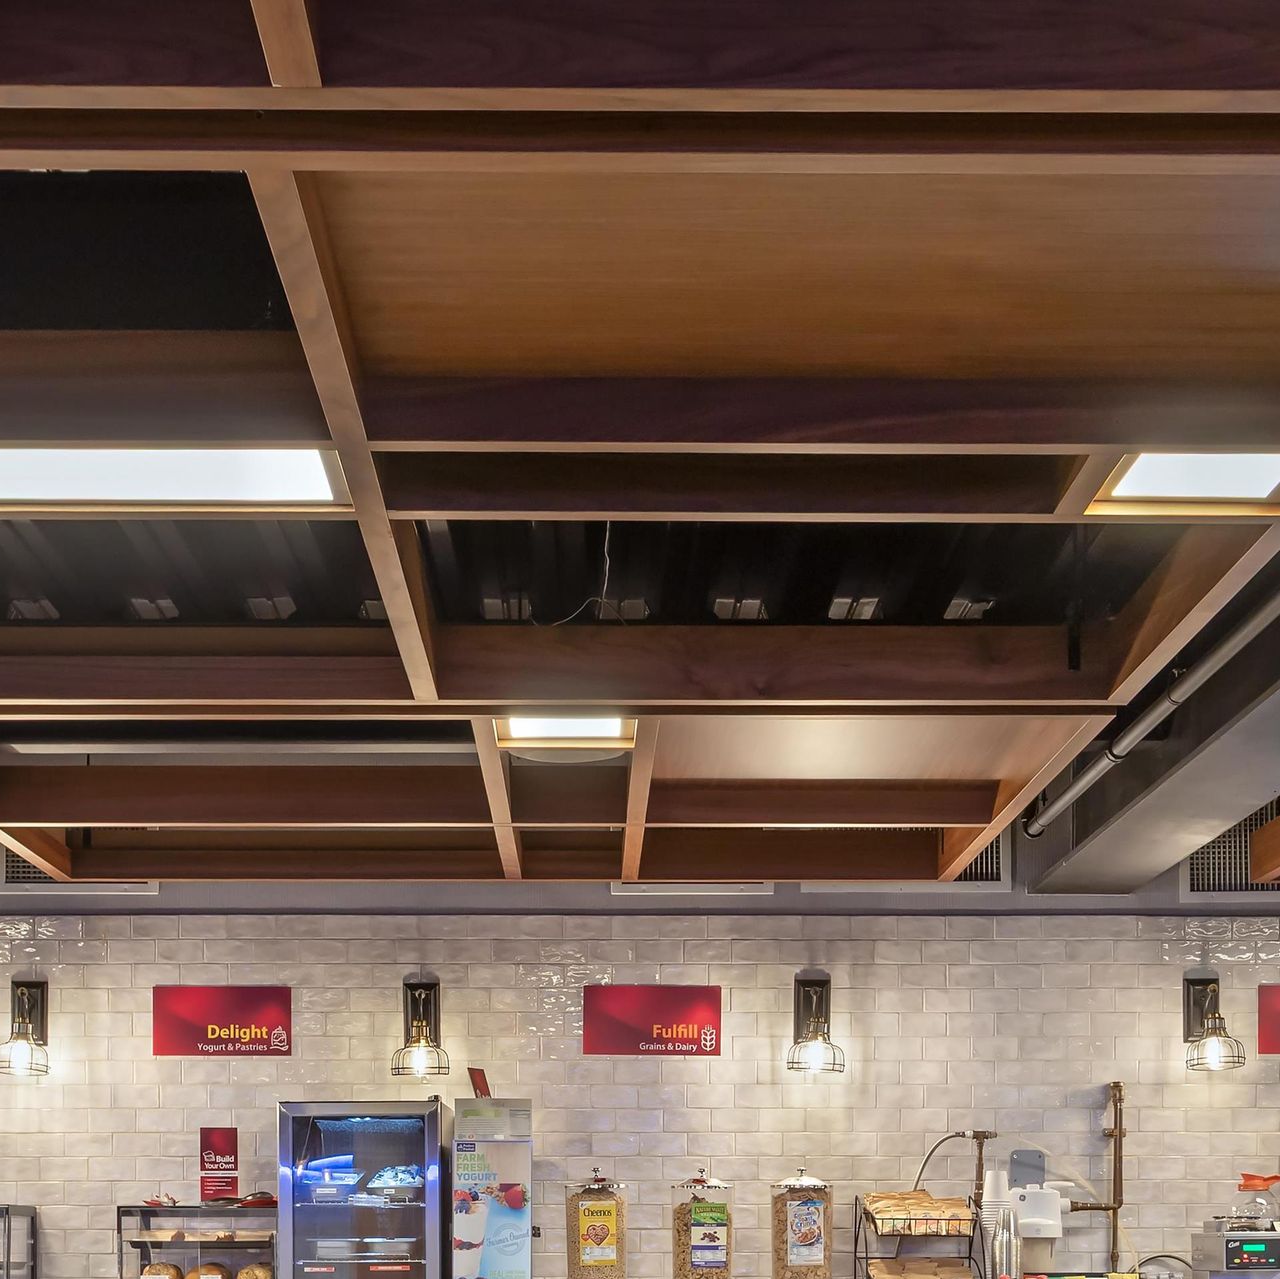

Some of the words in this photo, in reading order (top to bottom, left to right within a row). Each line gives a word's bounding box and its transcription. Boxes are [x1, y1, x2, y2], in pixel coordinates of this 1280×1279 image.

[207, 1024, 268, 1042] Delight
[652, 1024, 698, 1039] Fulfill
[197, 1043, 226, 1053] Yogurt
[227, 1043, 234, 1051] &
[235, 1043, 267, 1051] Pastries
[639, 1042, 666, 1051] Grains
[667, 1042, 674, 1051] &
[675, 1042, 698, 1053] Dairy
[215, 1155, 235, 1163] Build
[456, 1153, 486, 1162] FARM
[456, 1163, 490, 1171] FRESH
[456, 1173, 498, 1181] YOGURT
